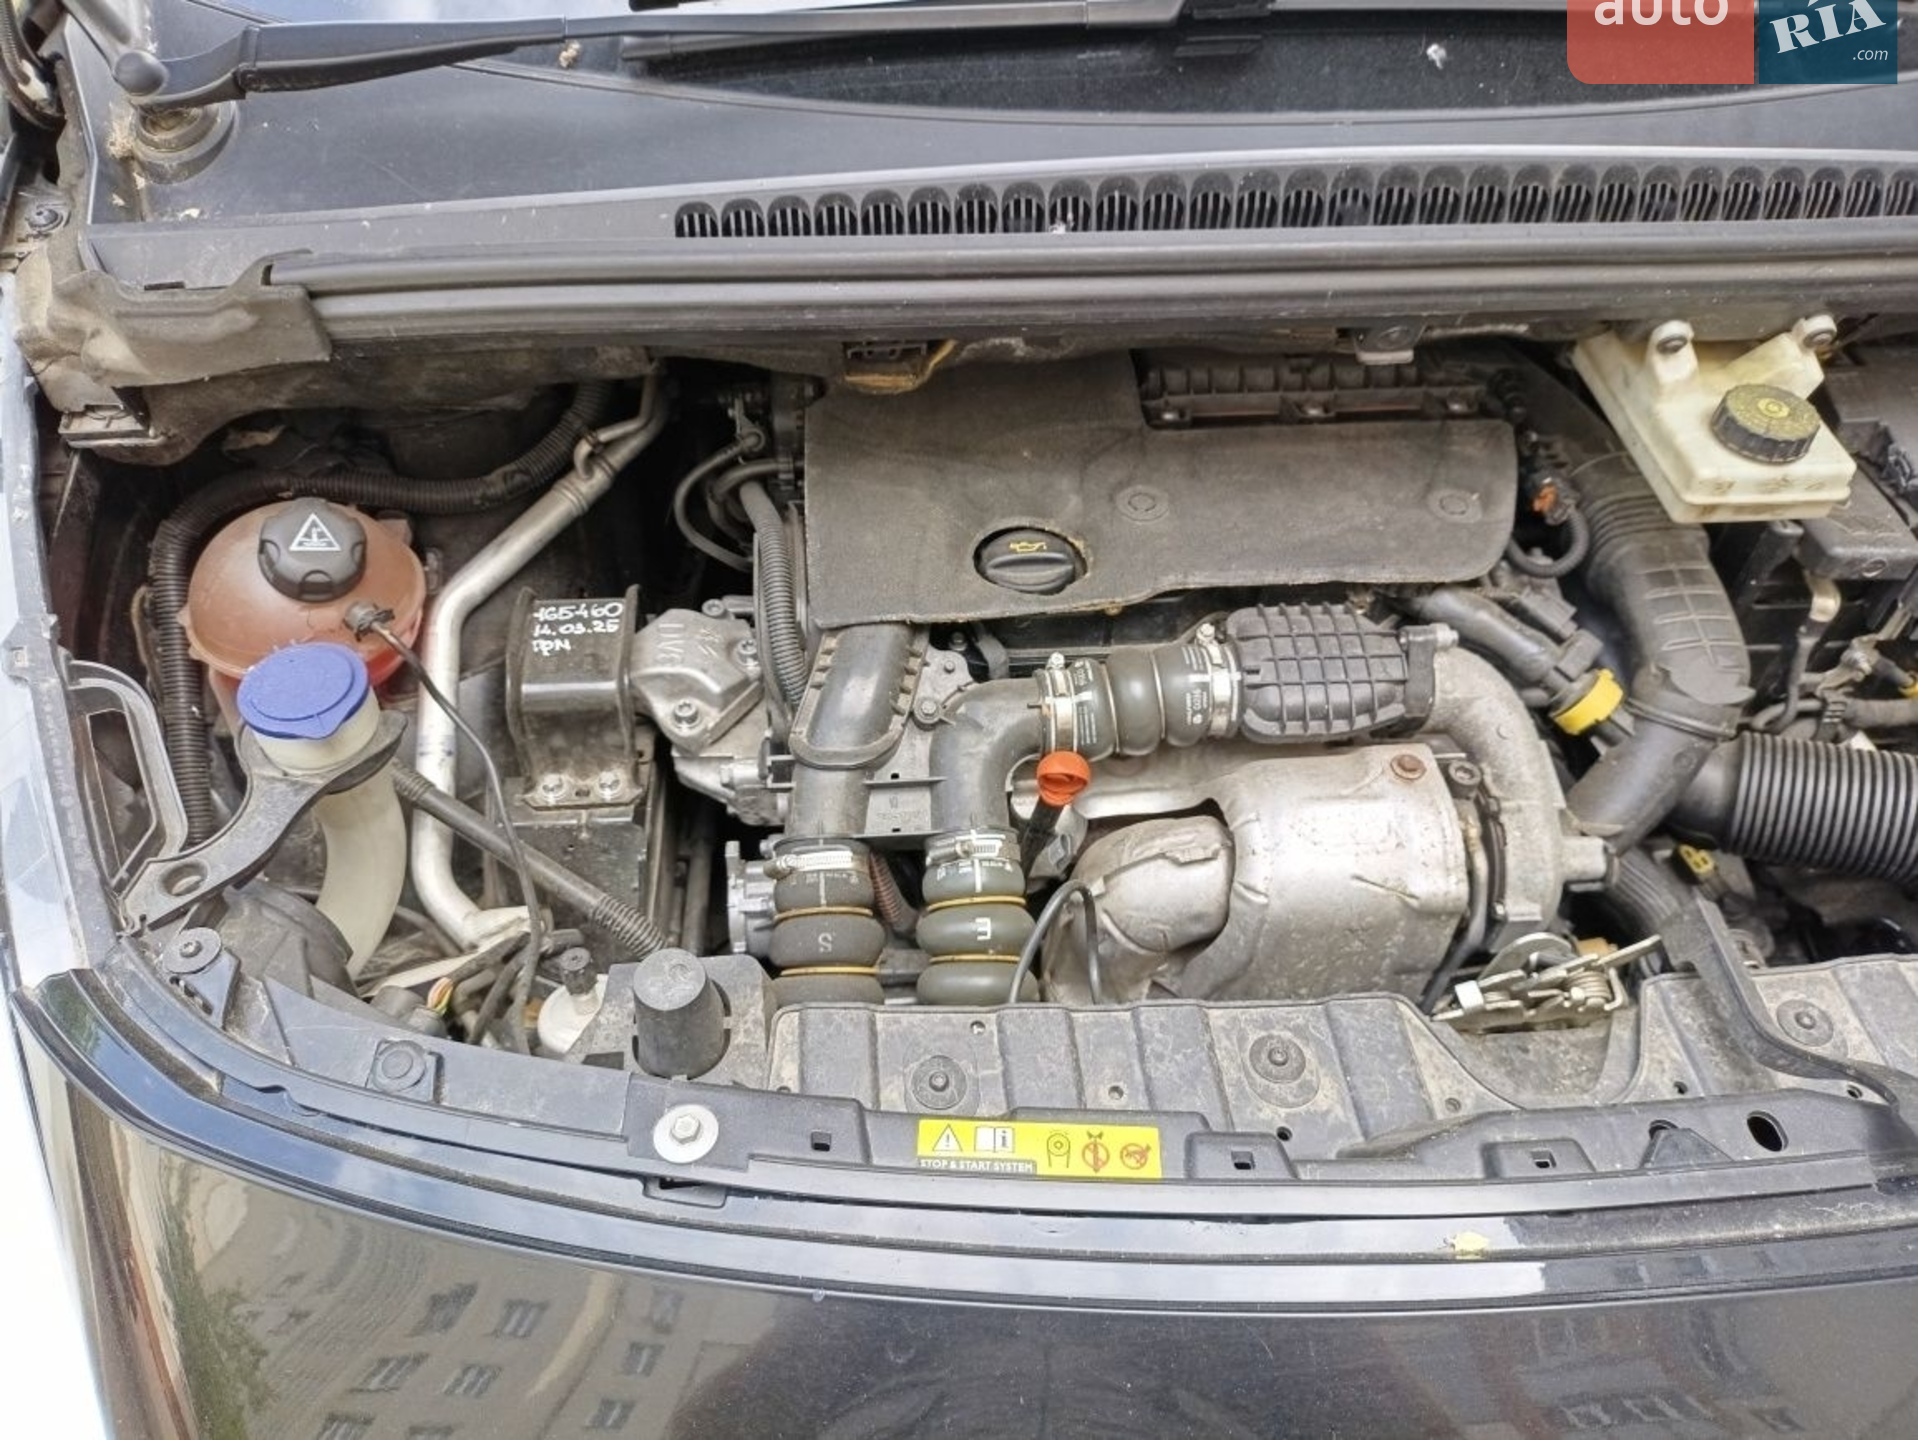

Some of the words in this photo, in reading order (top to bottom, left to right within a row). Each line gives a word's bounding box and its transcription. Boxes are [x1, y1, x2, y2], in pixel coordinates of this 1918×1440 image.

[920, 1158, 948, 1169] STOP
[960, 1160, 991, 1171] START
[994, 1161, 1033, 1173] SYSTEM
